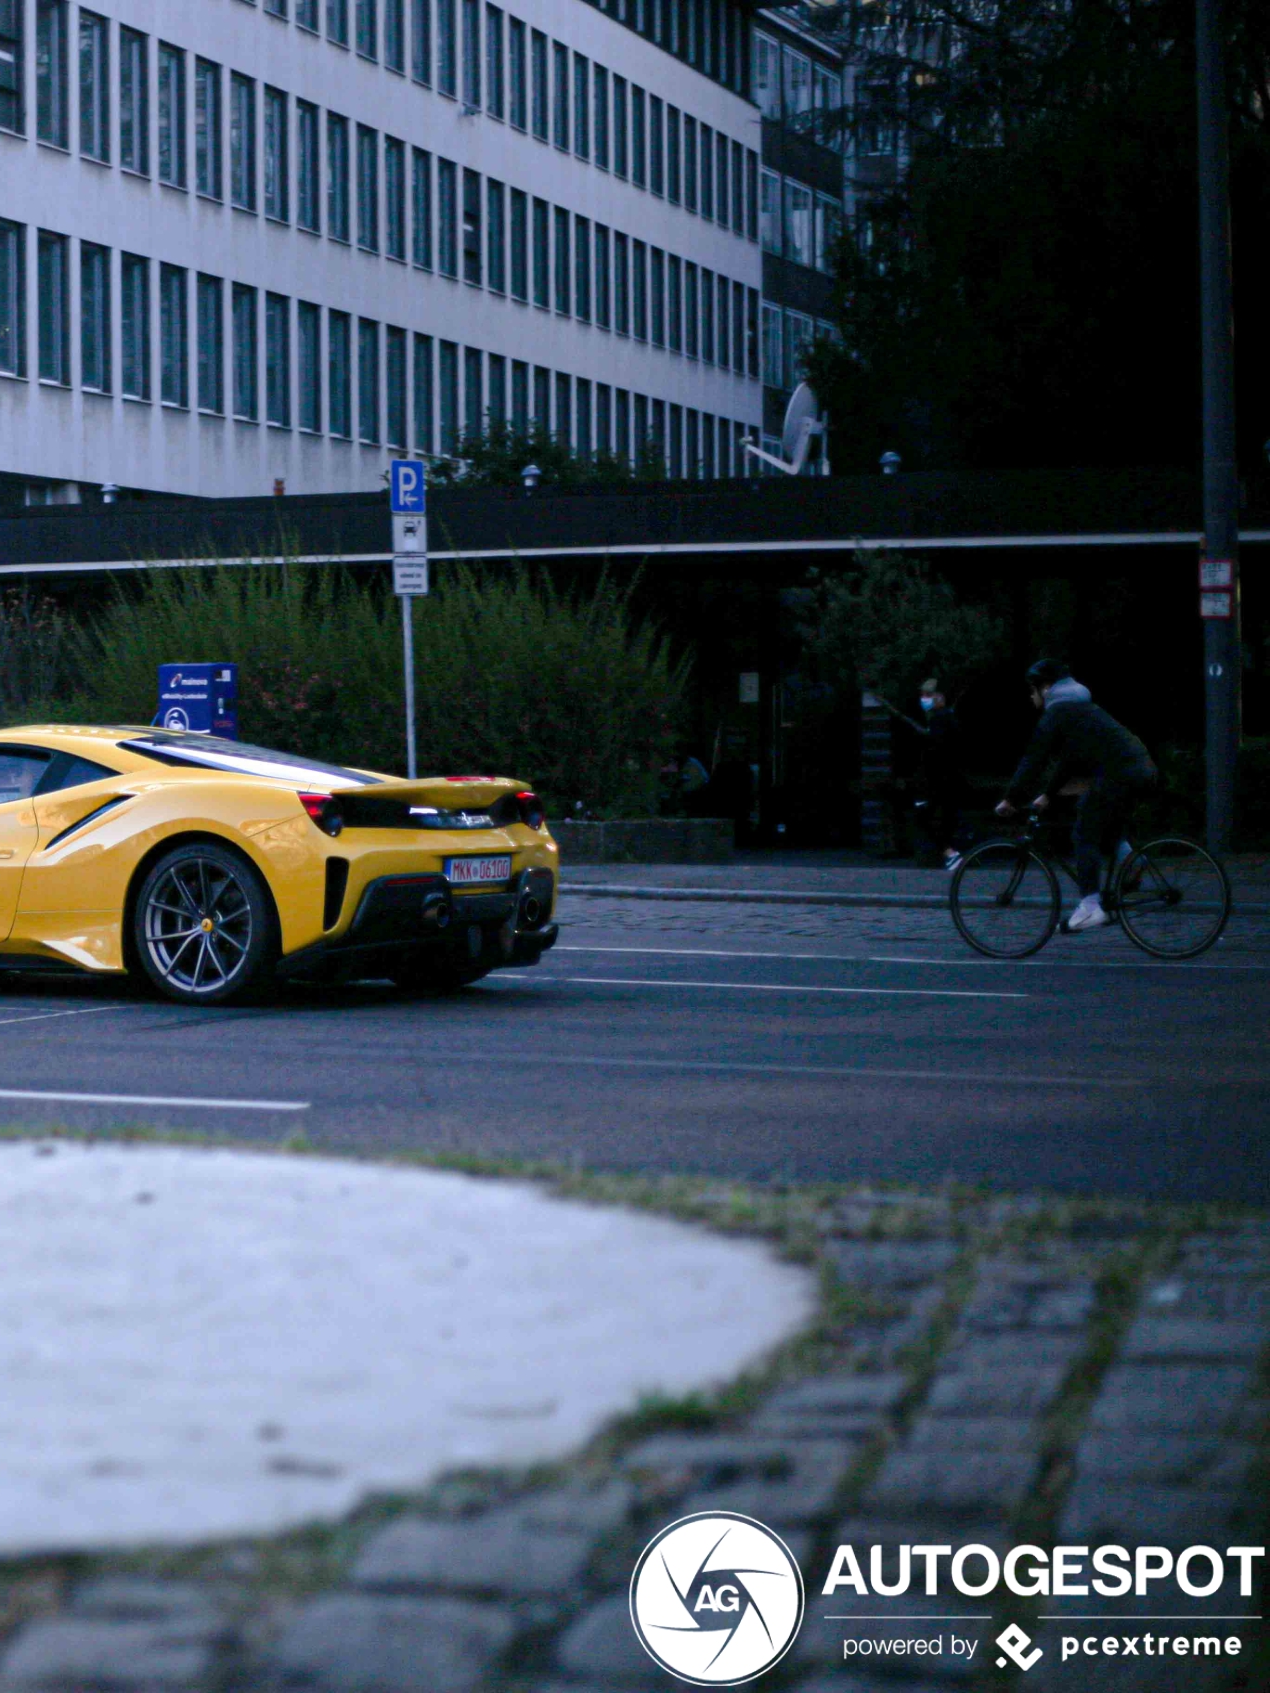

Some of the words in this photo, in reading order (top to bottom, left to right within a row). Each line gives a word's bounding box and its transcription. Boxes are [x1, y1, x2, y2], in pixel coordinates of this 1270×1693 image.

[398, 466, 417, 506] P
[453, 861, 472, 881] MKK
[479, 859, 509, 880] 06100
